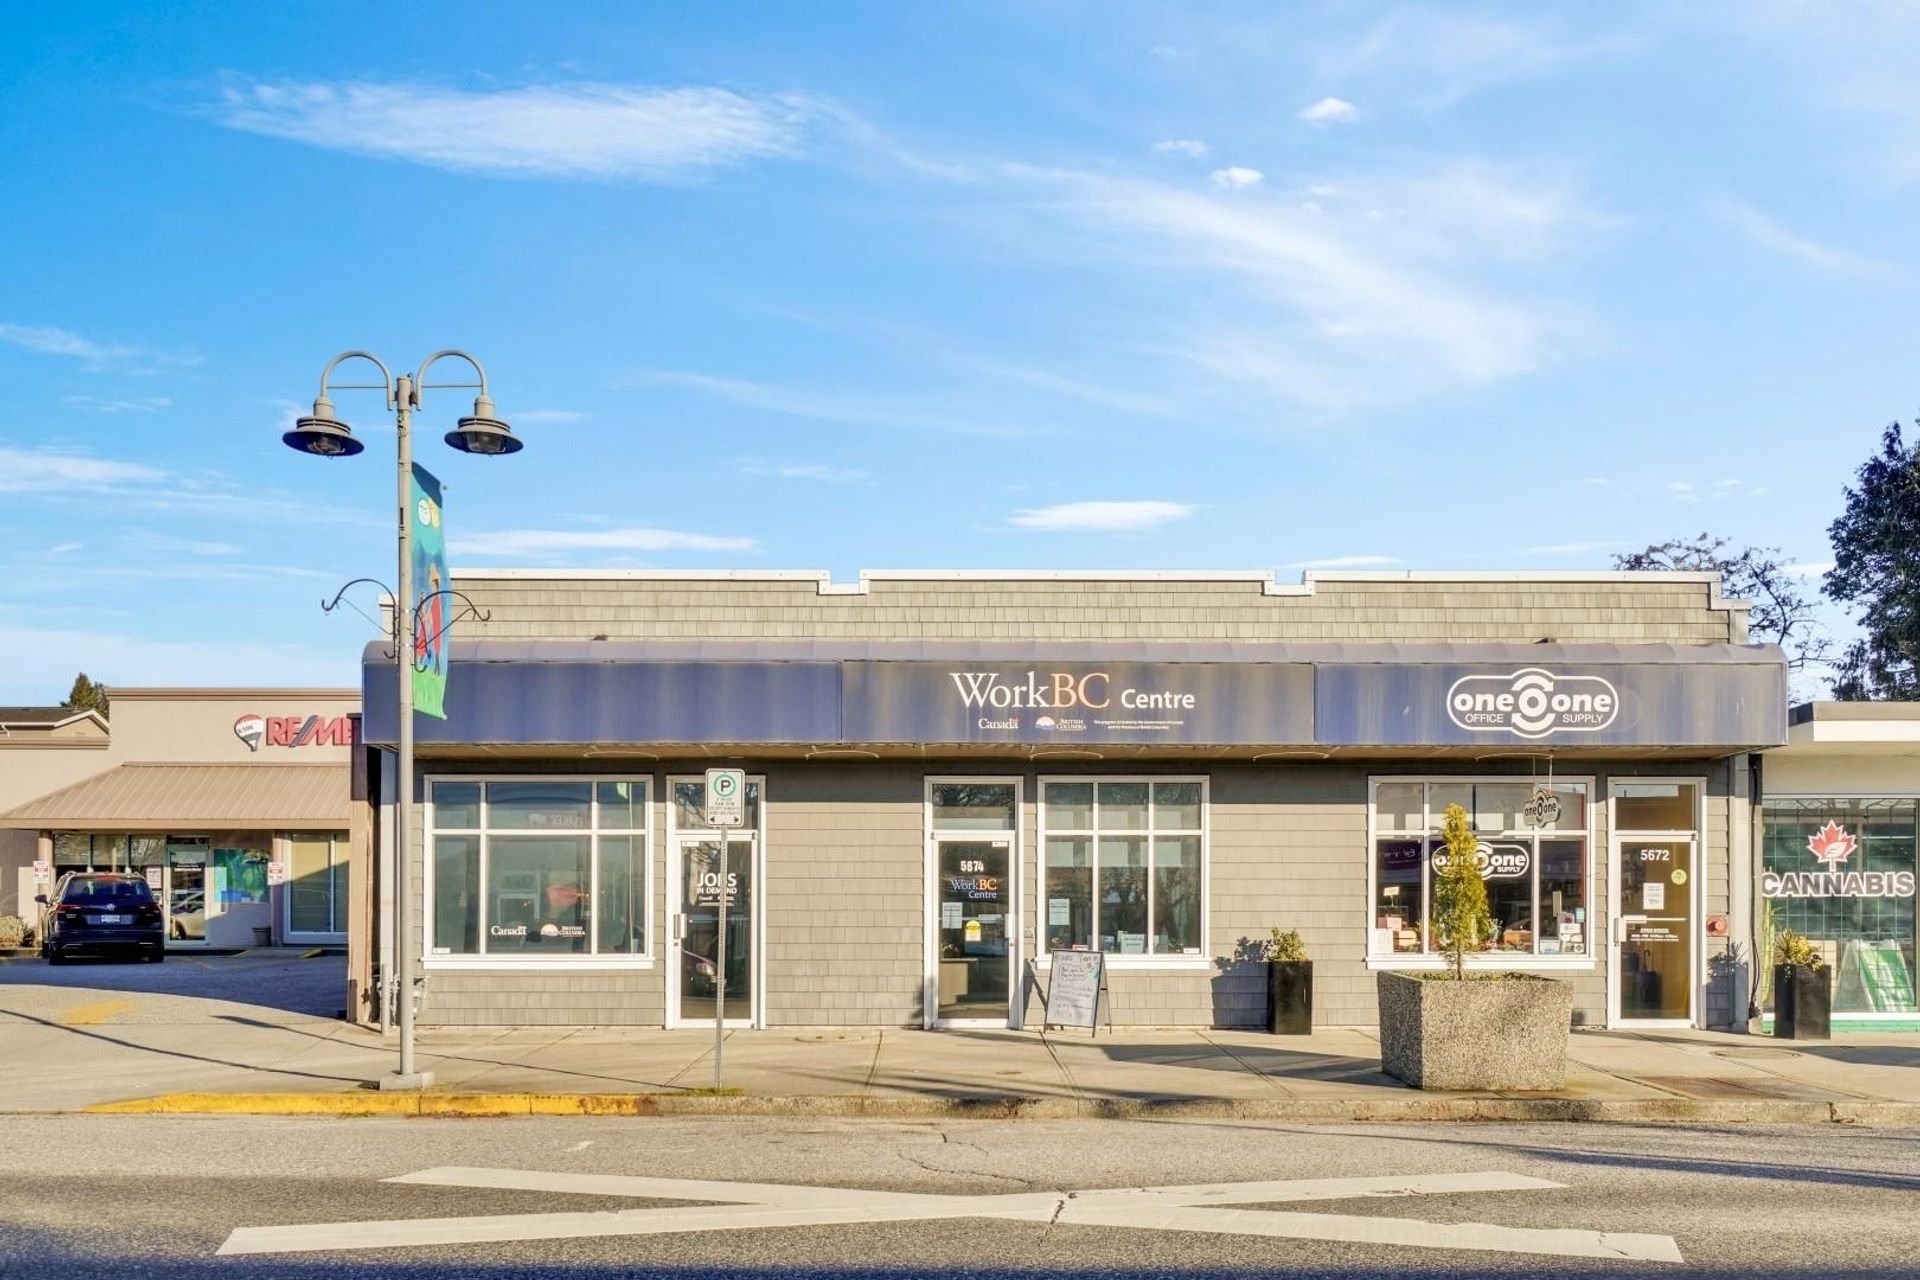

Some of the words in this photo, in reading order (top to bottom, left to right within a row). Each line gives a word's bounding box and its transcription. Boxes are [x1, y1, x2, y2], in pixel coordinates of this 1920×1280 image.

[949, 670, 1110, 709] WorkBC
[1121, 689, 1195, 709] Centre
[978, 717, 1019, 729] Canada
[1465, 713, 1504, 723] OFFICE
[1562, 713, 1604, 723] SUPPLY
[720, 779, 732, 792] P
[1490, 854, 1526, 867] one
[1640, 849, 1670, 861] 5672
[950, 878, 997, 890] WorkBC
[1761, 871, 1916, 898] CANNABIS
[968, 890, 997, 899] Centre
[491, 925, 527, 936] Canada
